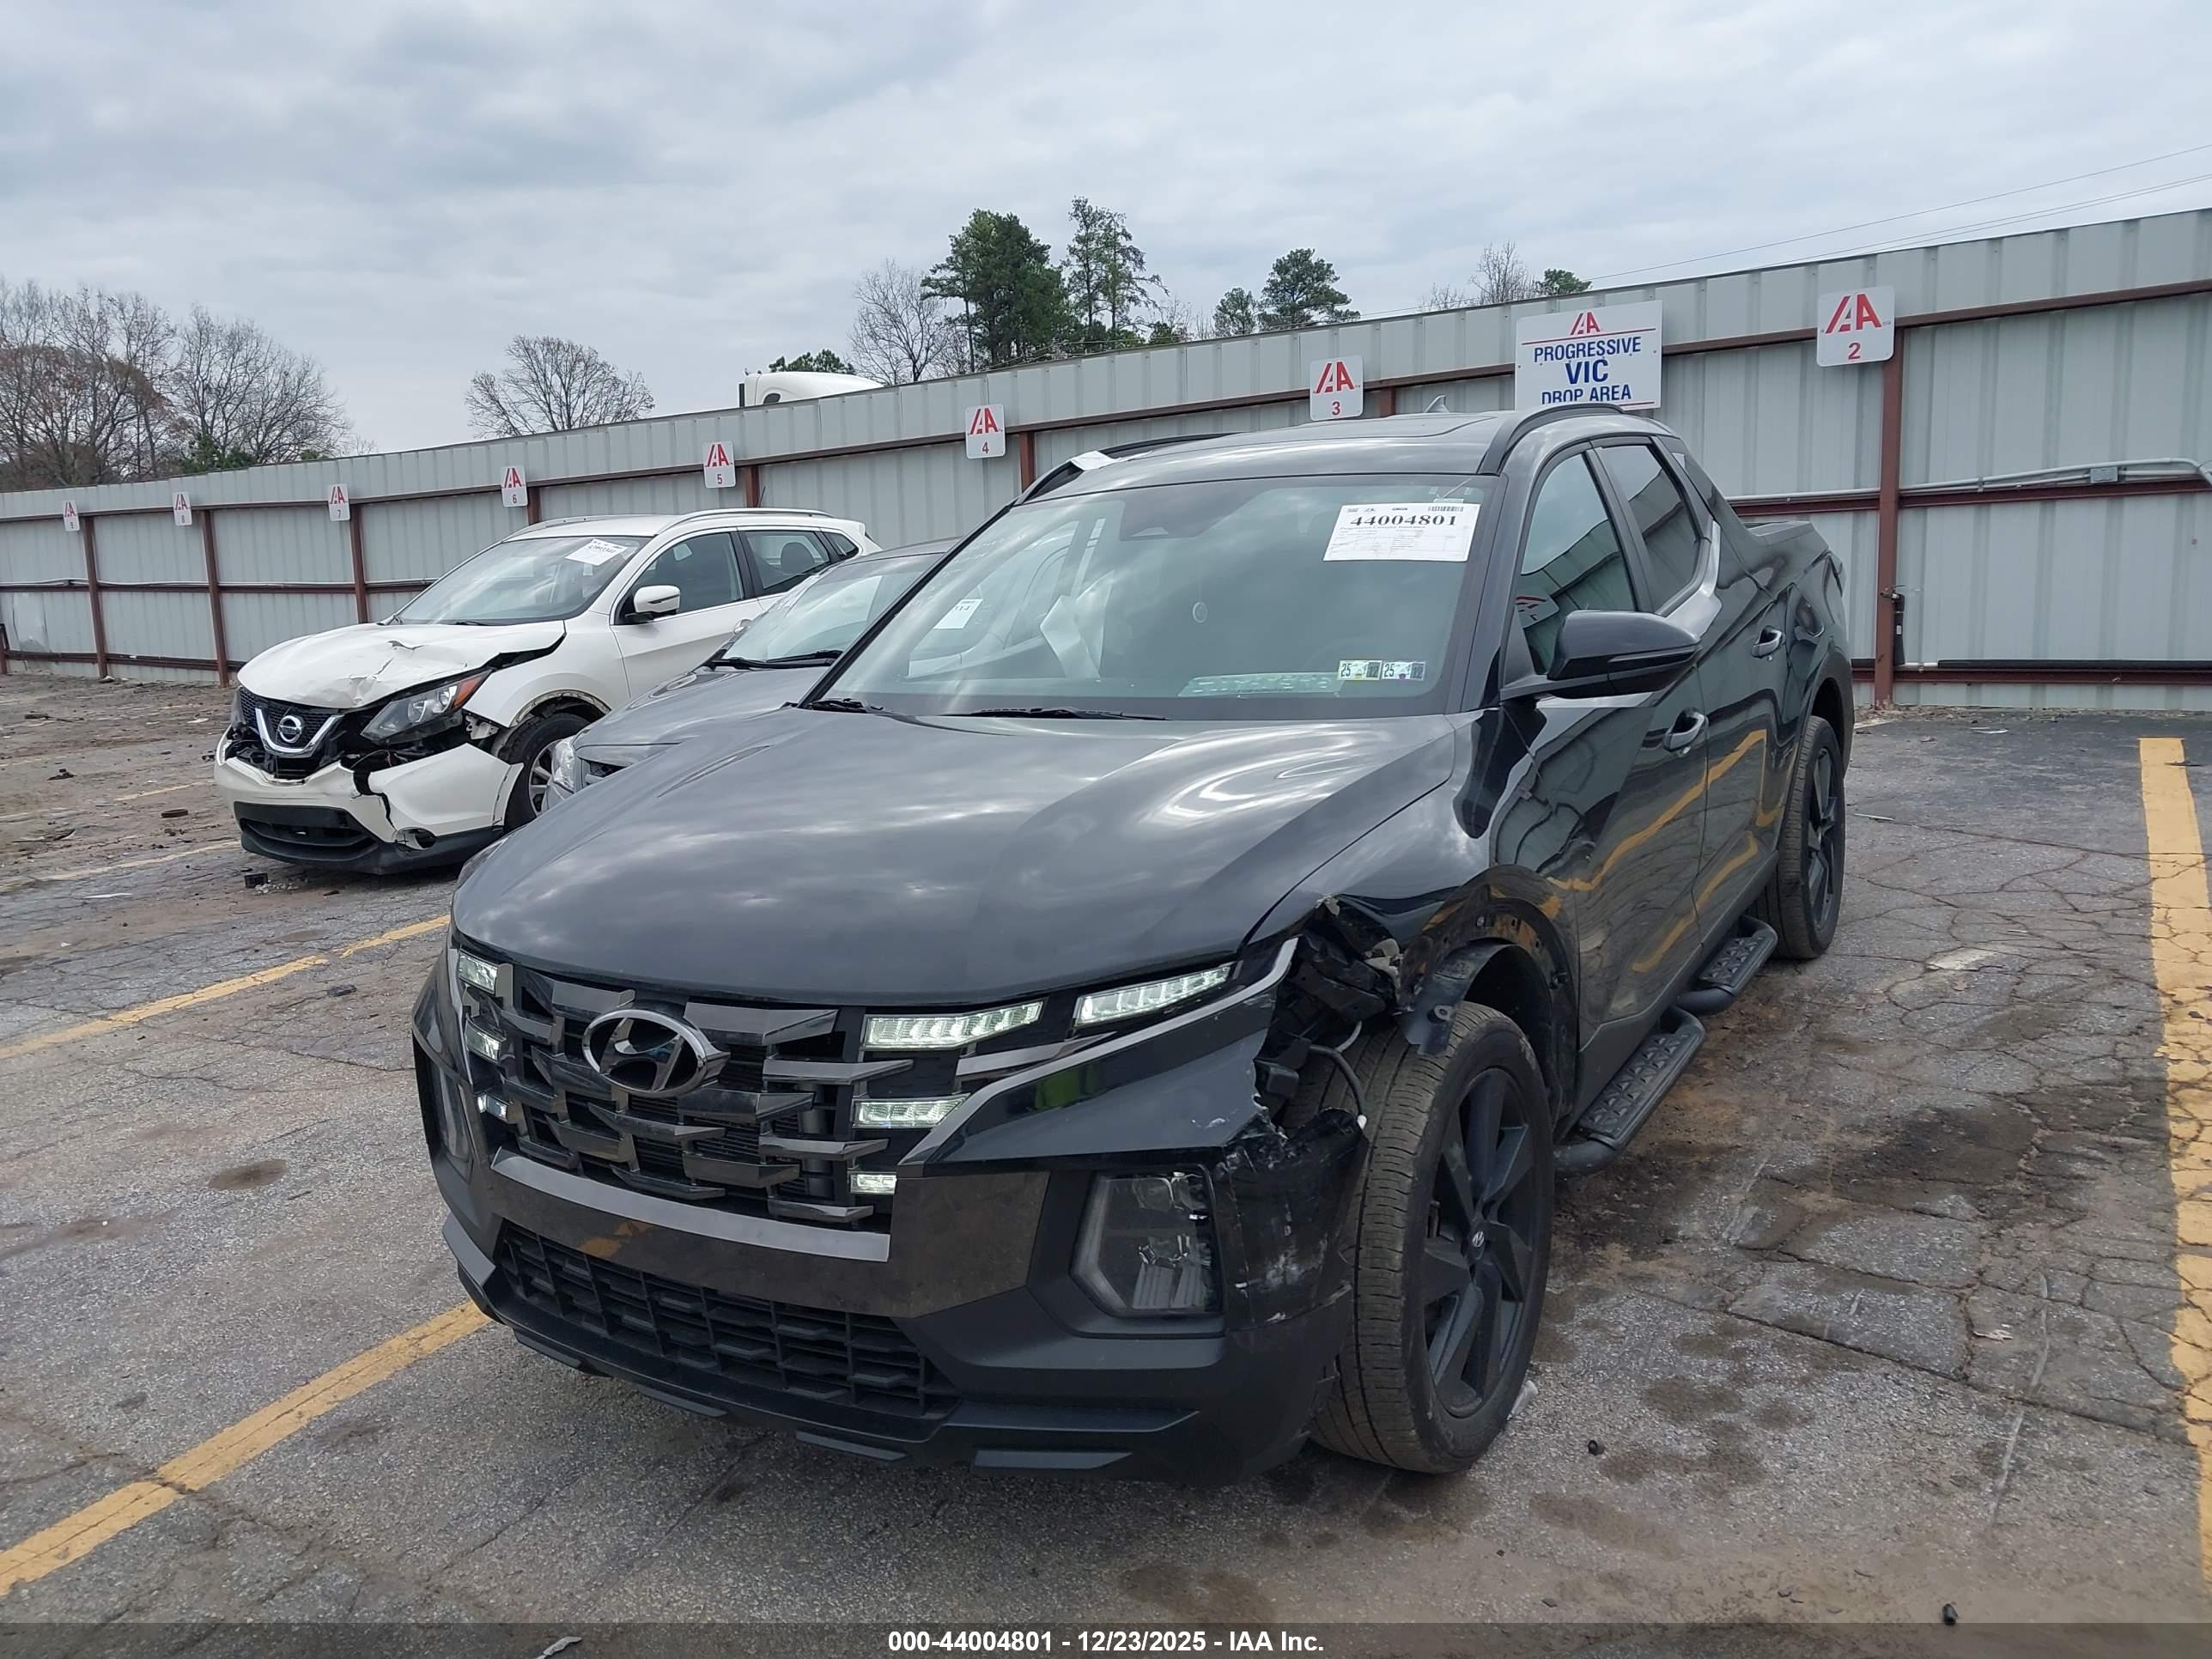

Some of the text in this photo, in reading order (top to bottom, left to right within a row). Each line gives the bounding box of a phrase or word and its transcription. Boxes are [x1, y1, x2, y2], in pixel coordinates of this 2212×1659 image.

[1534, 337, 1642, 362] PROGRESSIVE
[1848, 342, 1861, 360] 2
[1565, 359, 1608, 385] VIC
[1541, 384, 1632, 404] DROP AREA
[1332, 401, 1340, 416] 3
[981, 441, 989, 454] 4
[717, 473, 723, 484] 5
[512, 494, 518, 504] 6
[1349, 514, 1457, 526] 44004801
[1340, 663, 1351, 677] 25
[1383, 663, 1395, 678] 25
